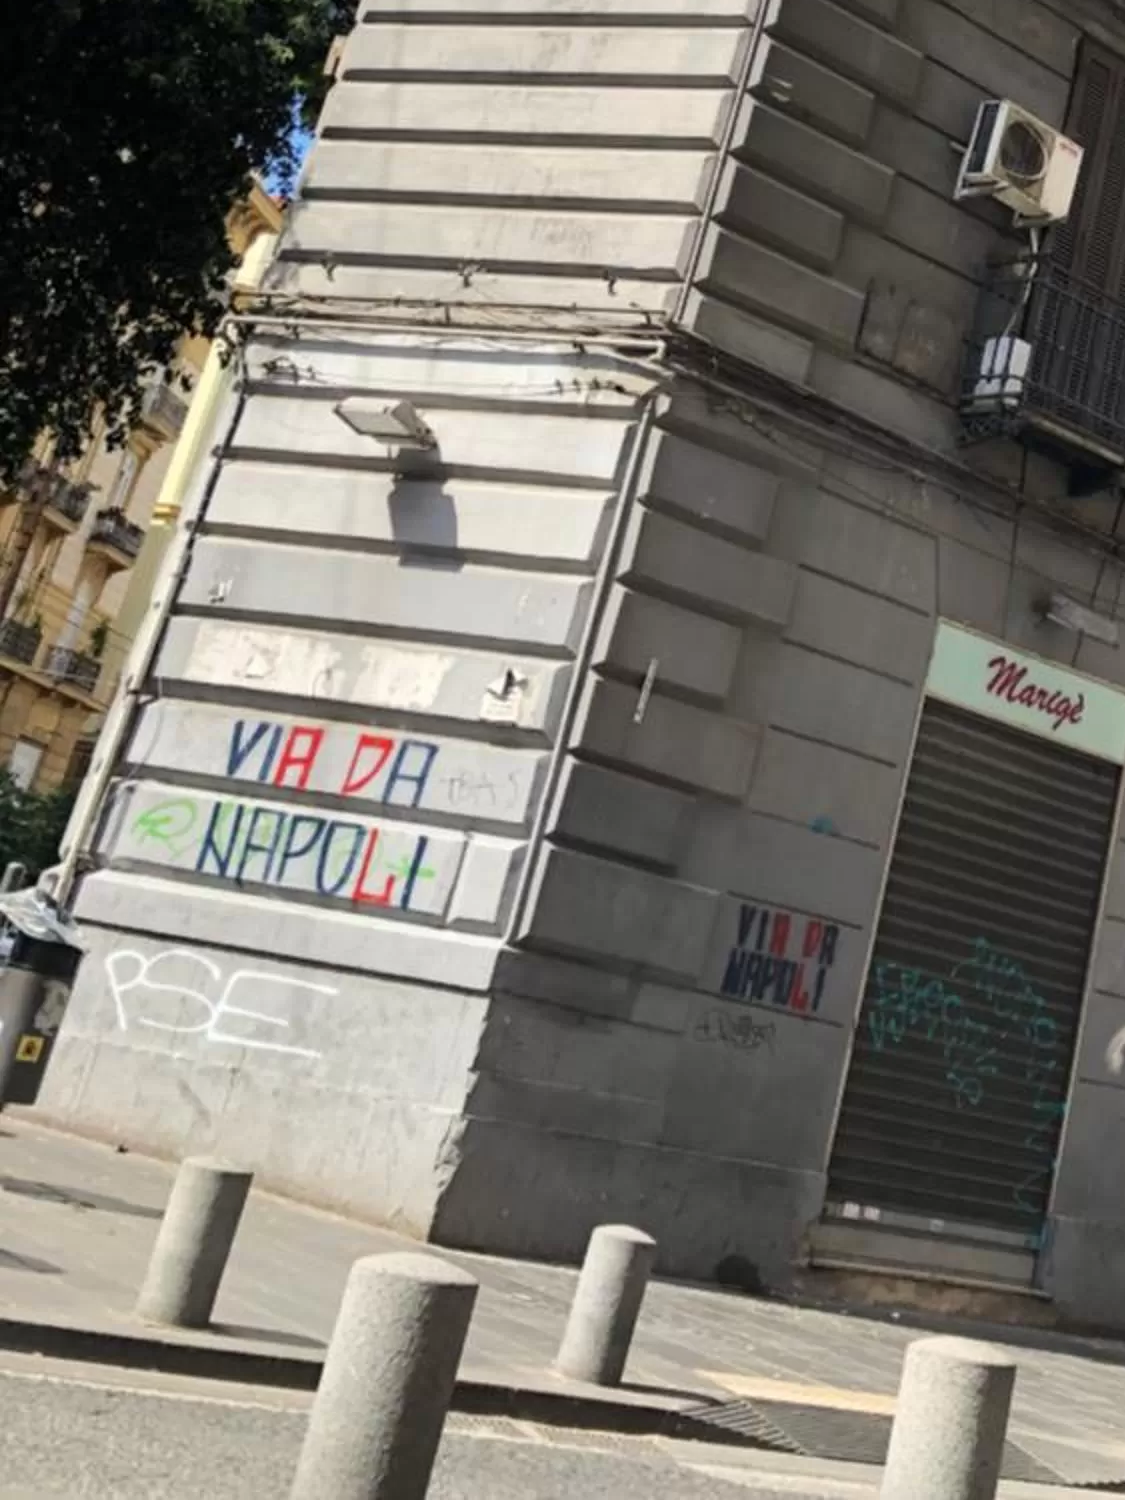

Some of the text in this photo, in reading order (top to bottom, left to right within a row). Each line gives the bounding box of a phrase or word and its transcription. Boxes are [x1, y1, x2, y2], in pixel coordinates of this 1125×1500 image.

[226, 719, 324, 791] VIA
[341, 733, 439, 808] DA
[195, 801, 428, 911] NAPOLI
